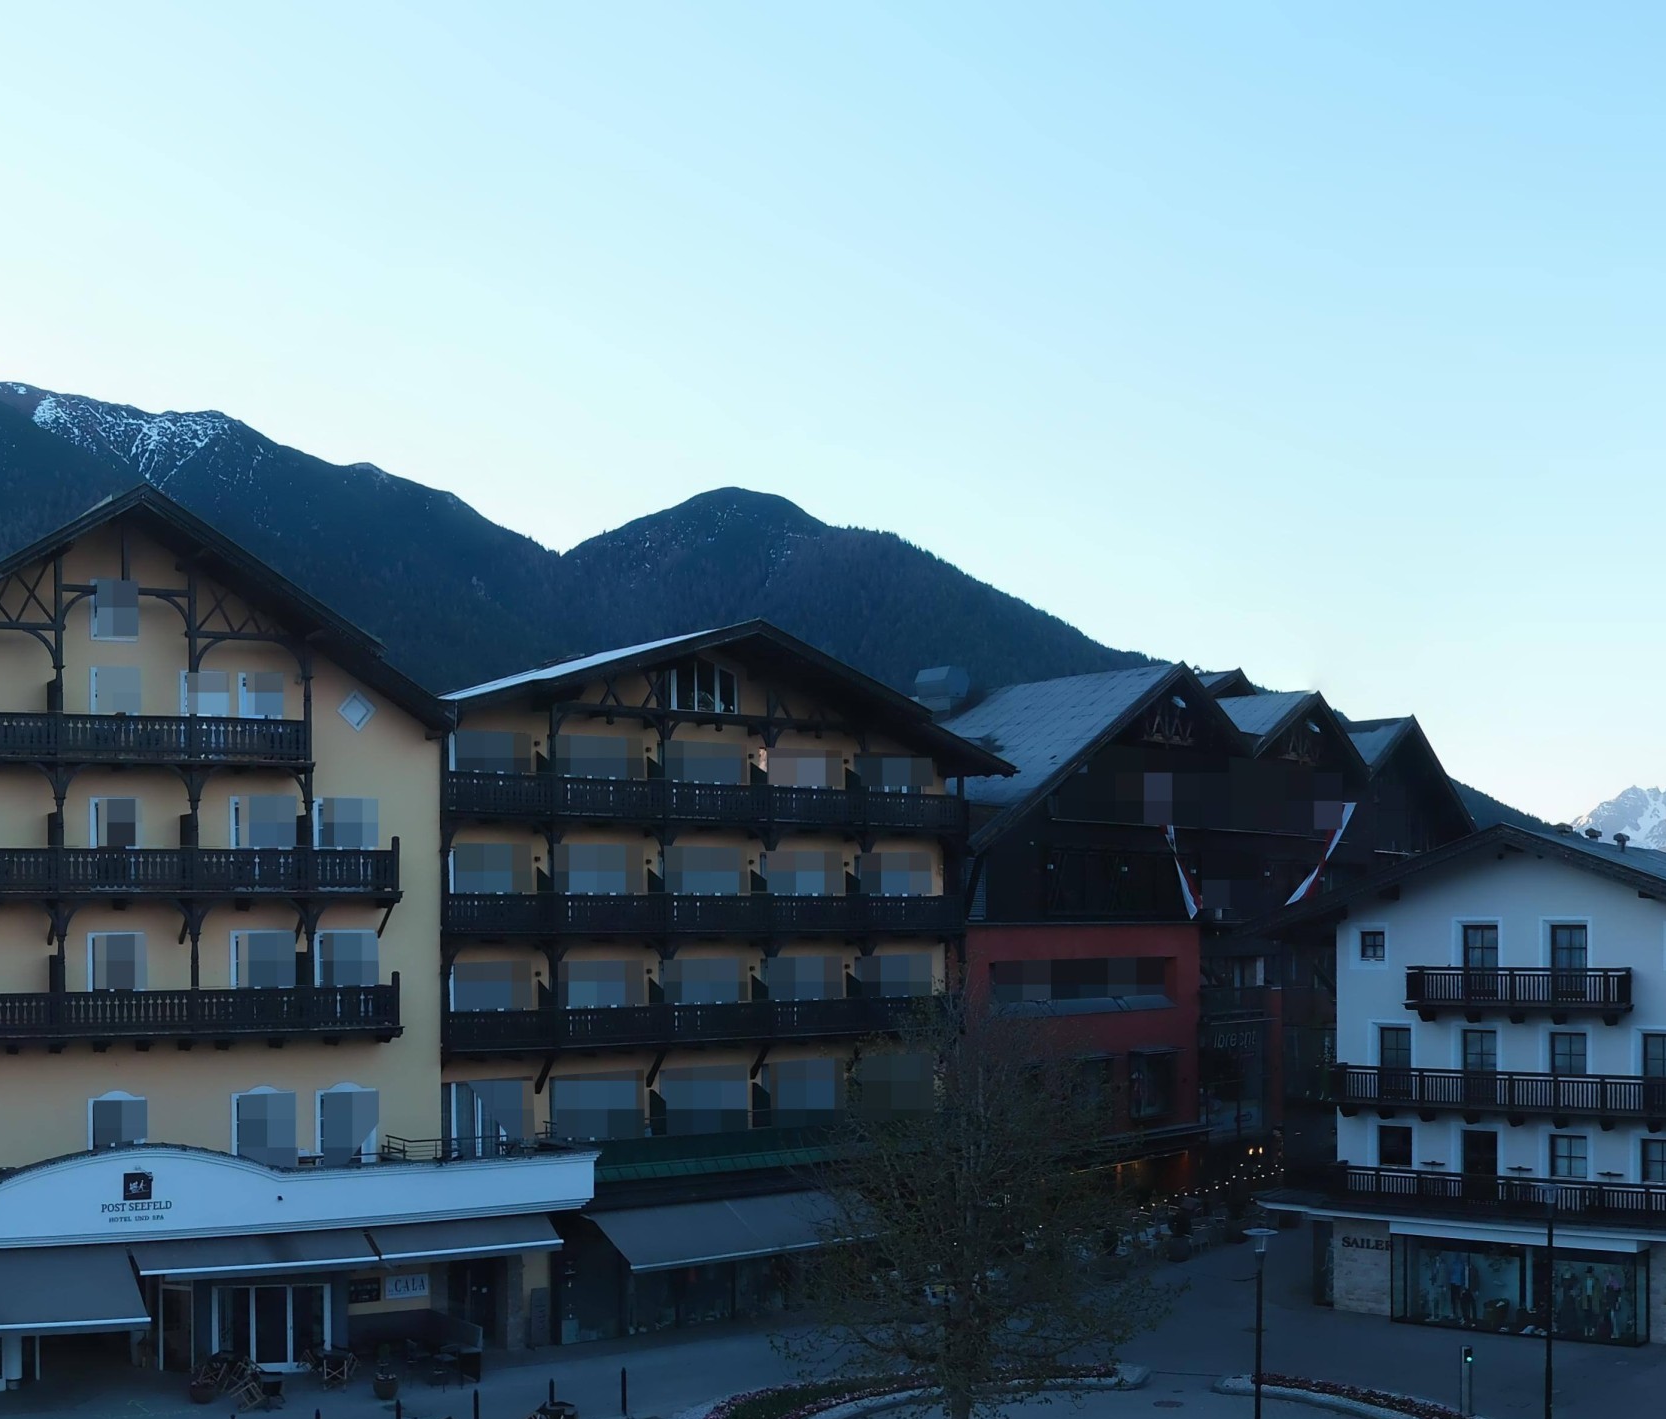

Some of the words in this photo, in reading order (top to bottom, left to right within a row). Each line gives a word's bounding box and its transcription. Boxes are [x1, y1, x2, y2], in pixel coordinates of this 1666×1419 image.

[101, 1202, 126, 1213] POST
[128, 1200, 172, 1211] SEEFELD
[394, 1277, 426, 1292] CALA
